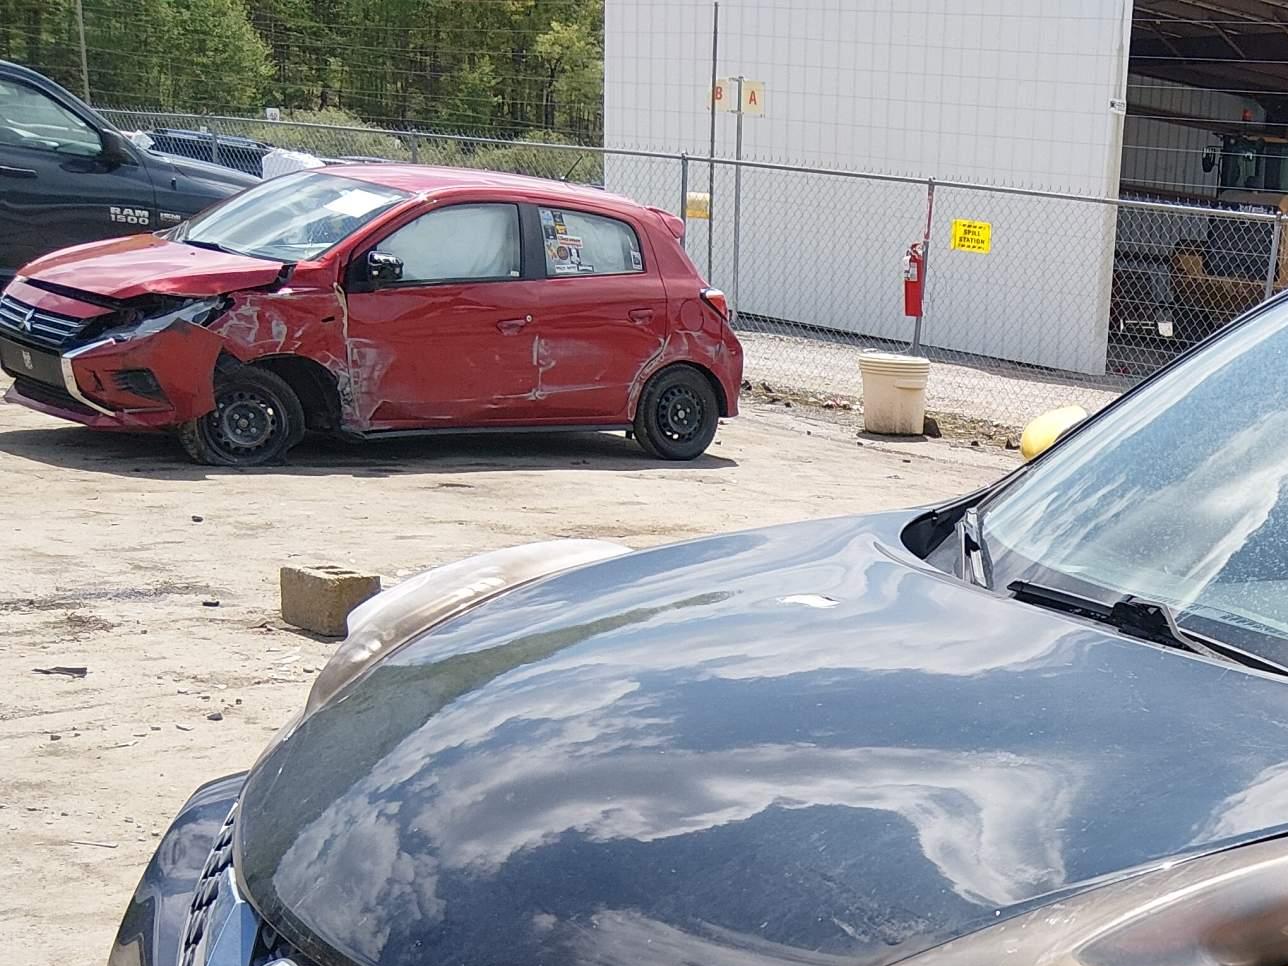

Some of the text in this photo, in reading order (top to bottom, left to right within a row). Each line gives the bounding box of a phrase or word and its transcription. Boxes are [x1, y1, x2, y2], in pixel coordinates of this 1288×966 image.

[748, 90, 757, 105] A
[110, 206, 149, 218] RAM
[110, 214, 149, 225] 1500
[963, 229, 981, 237] SPILL
[958, 236, 985, 245] STATION
